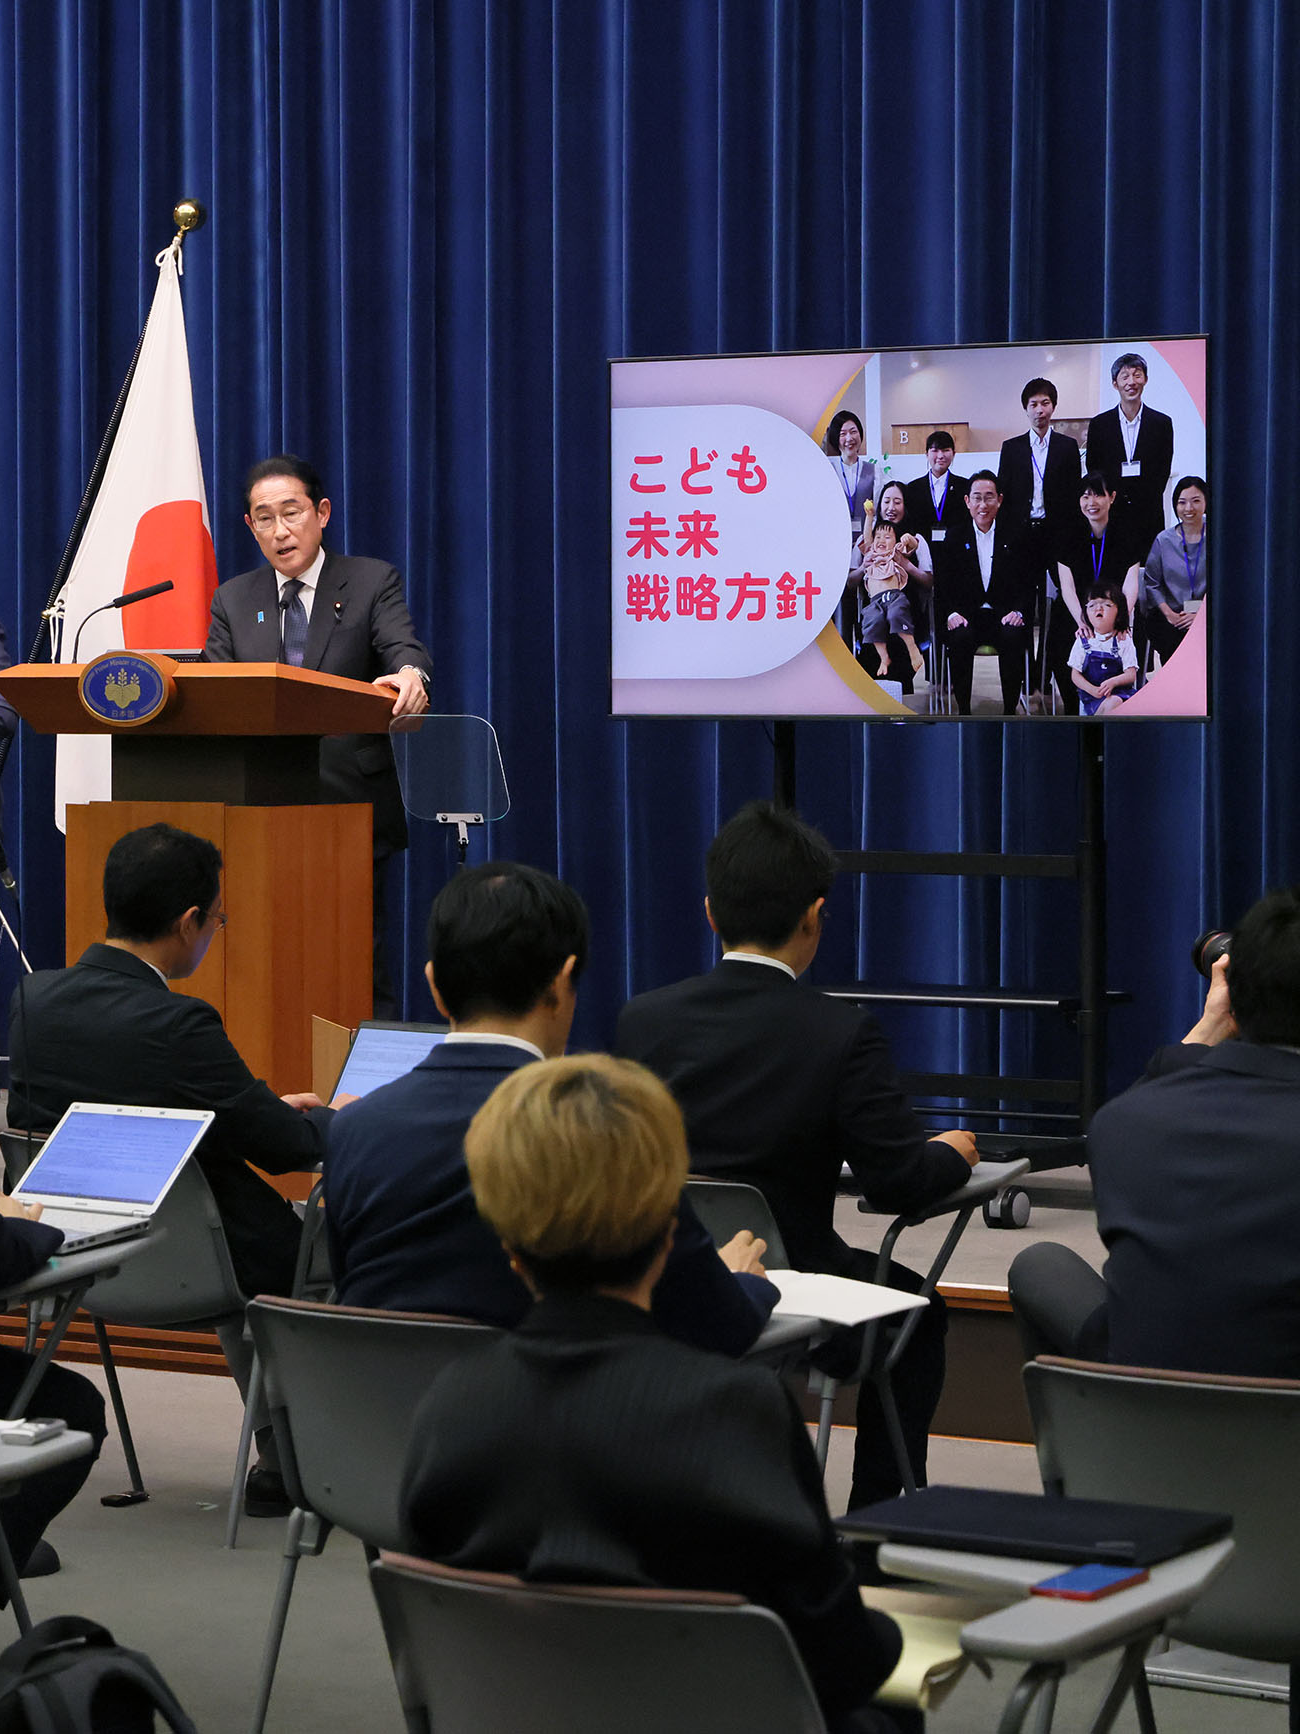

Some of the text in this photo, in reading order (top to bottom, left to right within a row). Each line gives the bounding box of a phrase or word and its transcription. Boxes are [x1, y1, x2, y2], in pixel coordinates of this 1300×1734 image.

[629, 445, 768, 495] こども
[625, 509, 720, 560] 未来
[625, 570, 822, 623] 戦略方針
